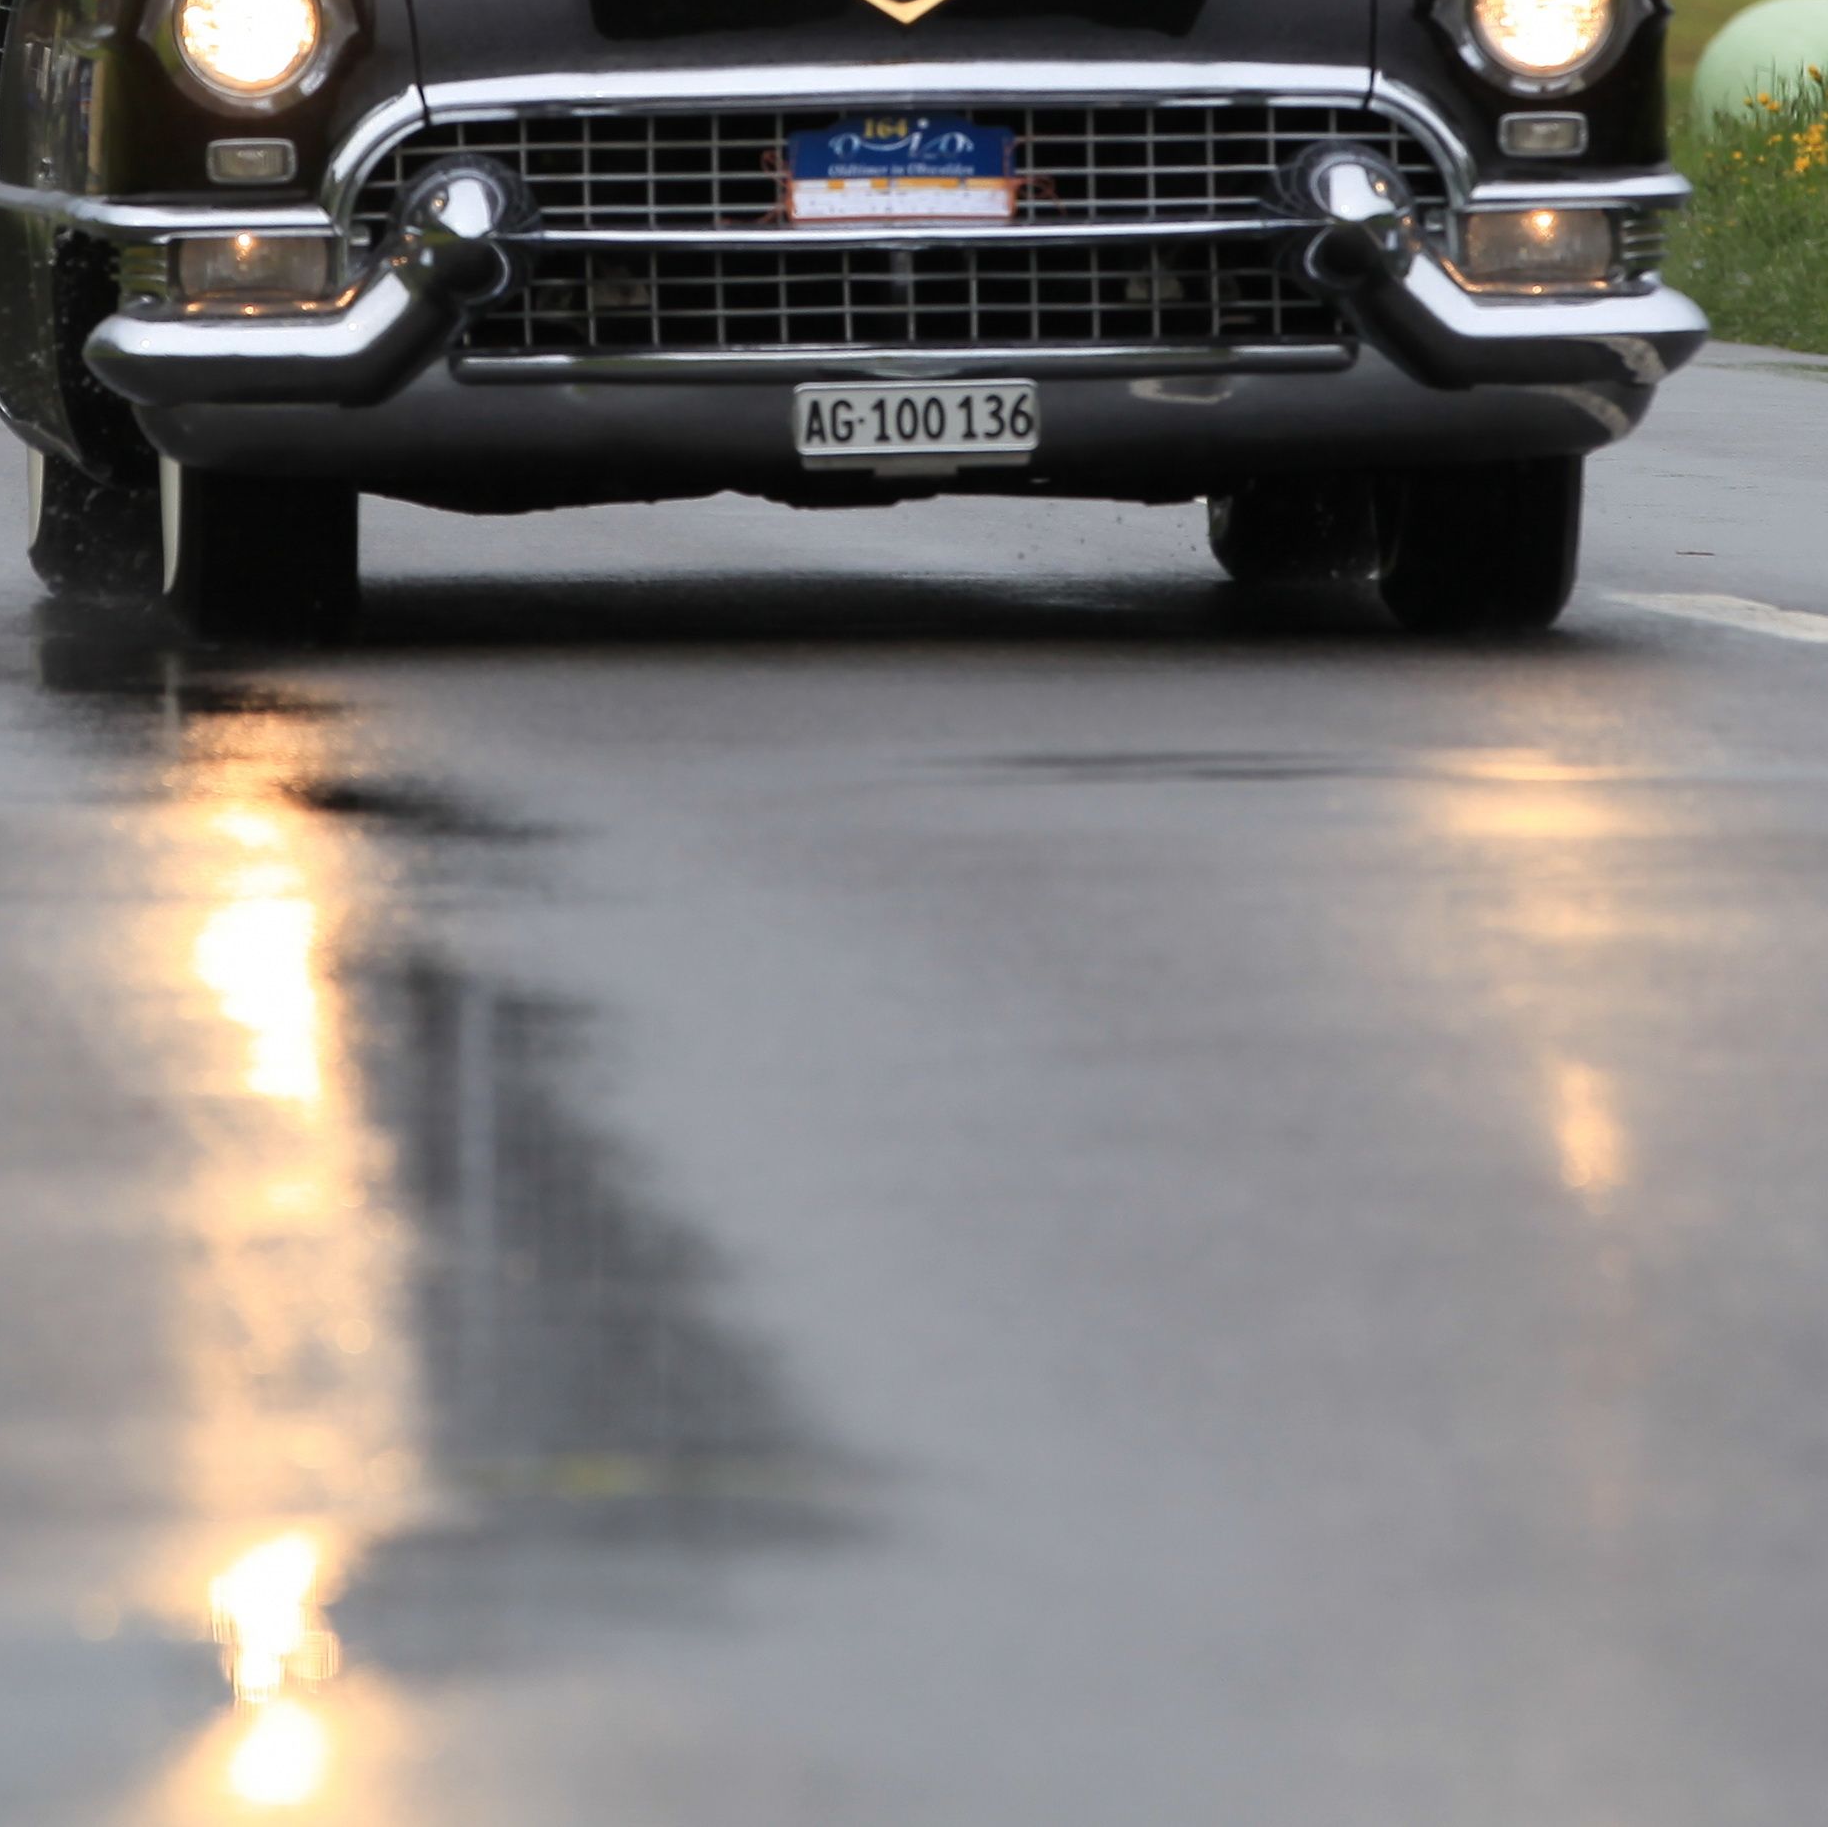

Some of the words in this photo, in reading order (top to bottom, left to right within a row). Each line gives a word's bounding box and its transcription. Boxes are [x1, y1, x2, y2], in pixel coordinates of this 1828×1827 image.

[864, 118, 908, 139] 164
[828, 163, 888, 177] Oldtimer
[890, 164, 904, 176] in
[958, 394, 1034, 439] 136
